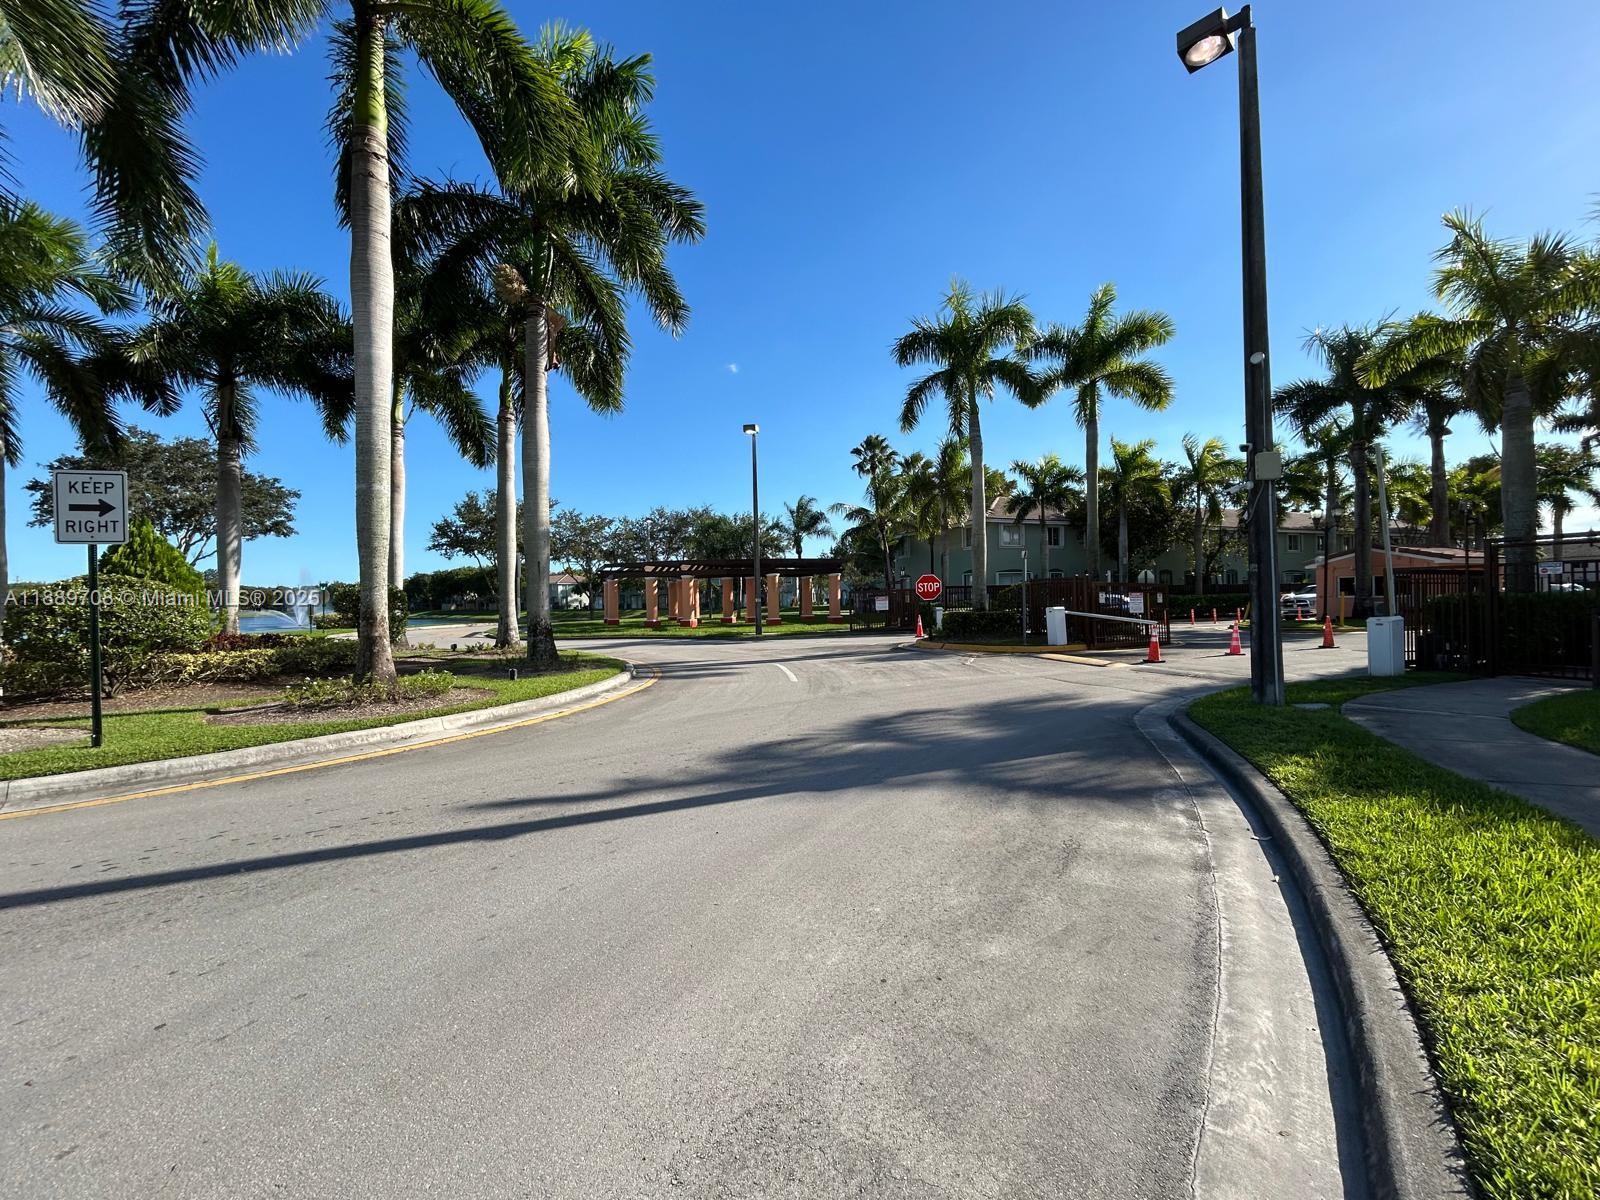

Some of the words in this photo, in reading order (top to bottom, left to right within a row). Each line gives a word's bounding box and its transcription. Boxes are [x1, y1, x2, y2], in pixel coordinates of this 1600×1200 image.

[68, 481, 114, 494] KEEP
[65, 520, 119, 533] RIGHT
[918, 582, 940, 593] STOP
